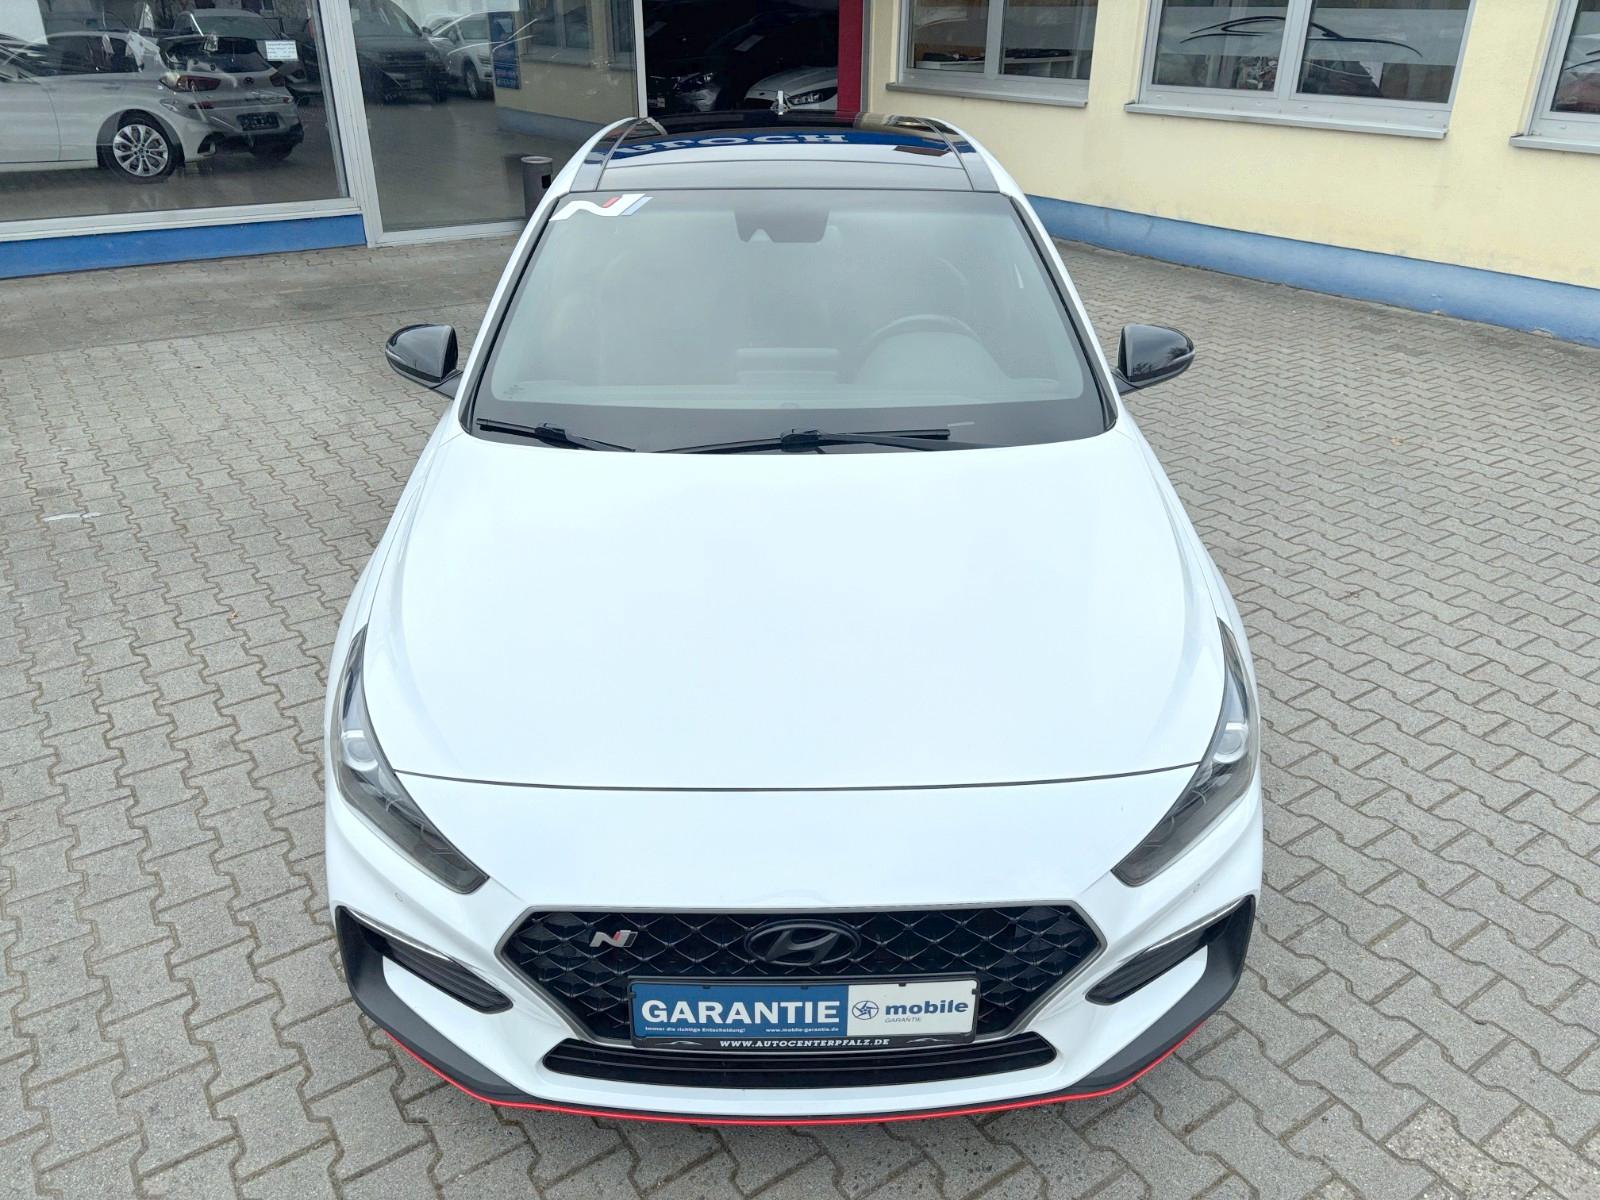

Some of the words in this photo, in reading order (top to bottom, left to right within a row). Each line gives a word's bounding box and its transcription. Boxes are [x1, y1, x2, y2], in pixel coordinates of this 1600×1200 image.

[641, 999, 840, 1024] GARANTIE
[885, 1000, 969, 1015] mobile
[719, 1038, 890, 1048] WWW.AUTOCENTERPFALZ.DE
